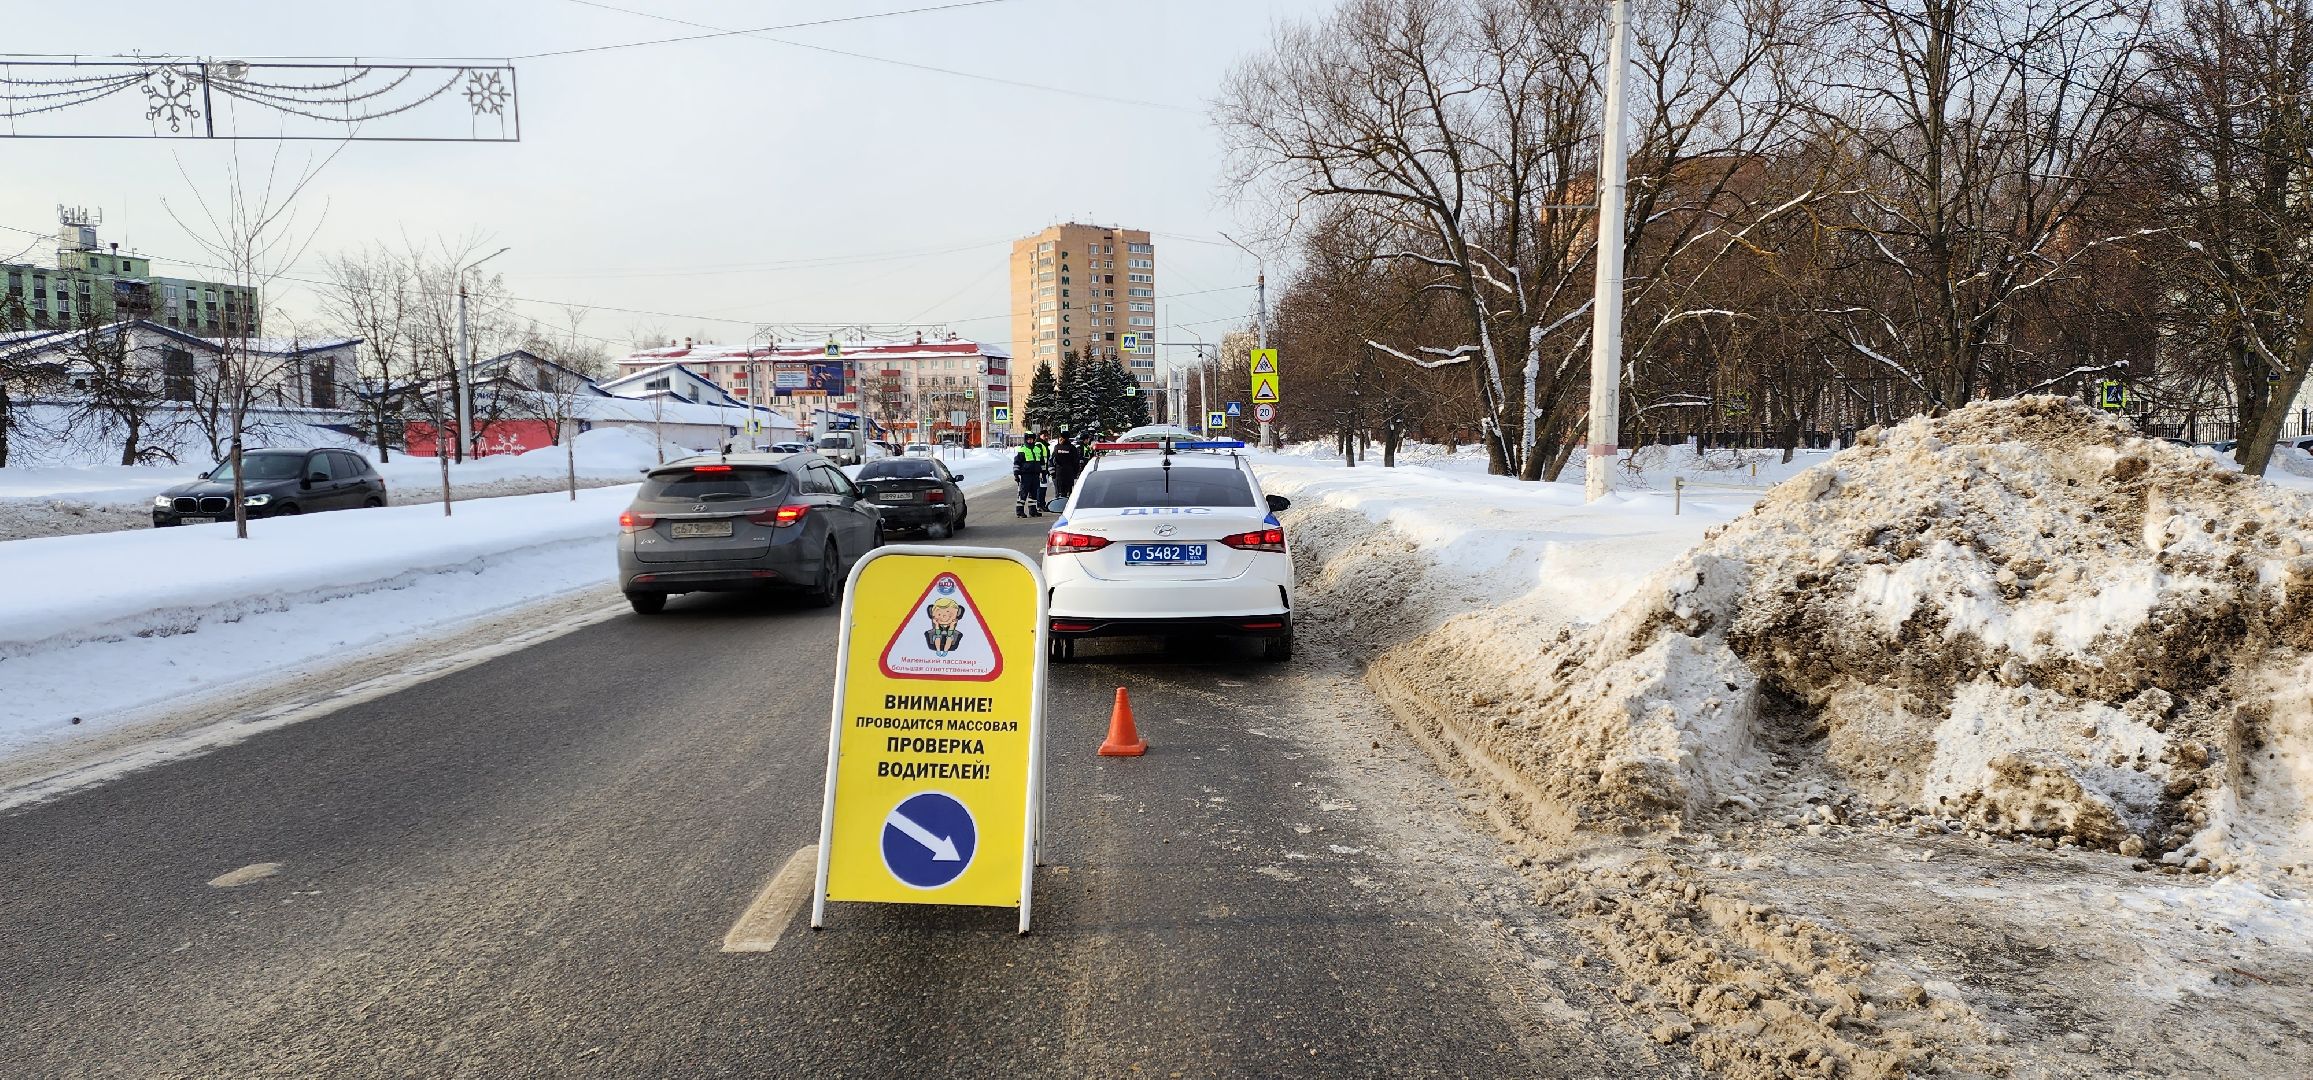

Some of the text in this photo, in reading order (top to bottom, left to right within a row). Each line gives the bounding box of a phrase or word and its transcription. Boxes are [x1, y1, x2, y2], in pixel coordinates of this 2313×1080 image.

[1259, 408, 1270, 417] 20
[1120, 507, 1211, 516] ДПС
[1146, 547, 1180, 560] 5482
[1188, 545, 1202, 556] 50
[942, 657, 977, 667] пассажир
[884, 694, 993, 713] ВНИМАНИЕ!
[855, 716, 1018, 732] ПРОВОДИТСЯ МАССОВАЯ
[886, 736, 985, 755] ПРОВЕРКА
[877, 759, 990, 781] ВОДИТЕЛЕЙ!
